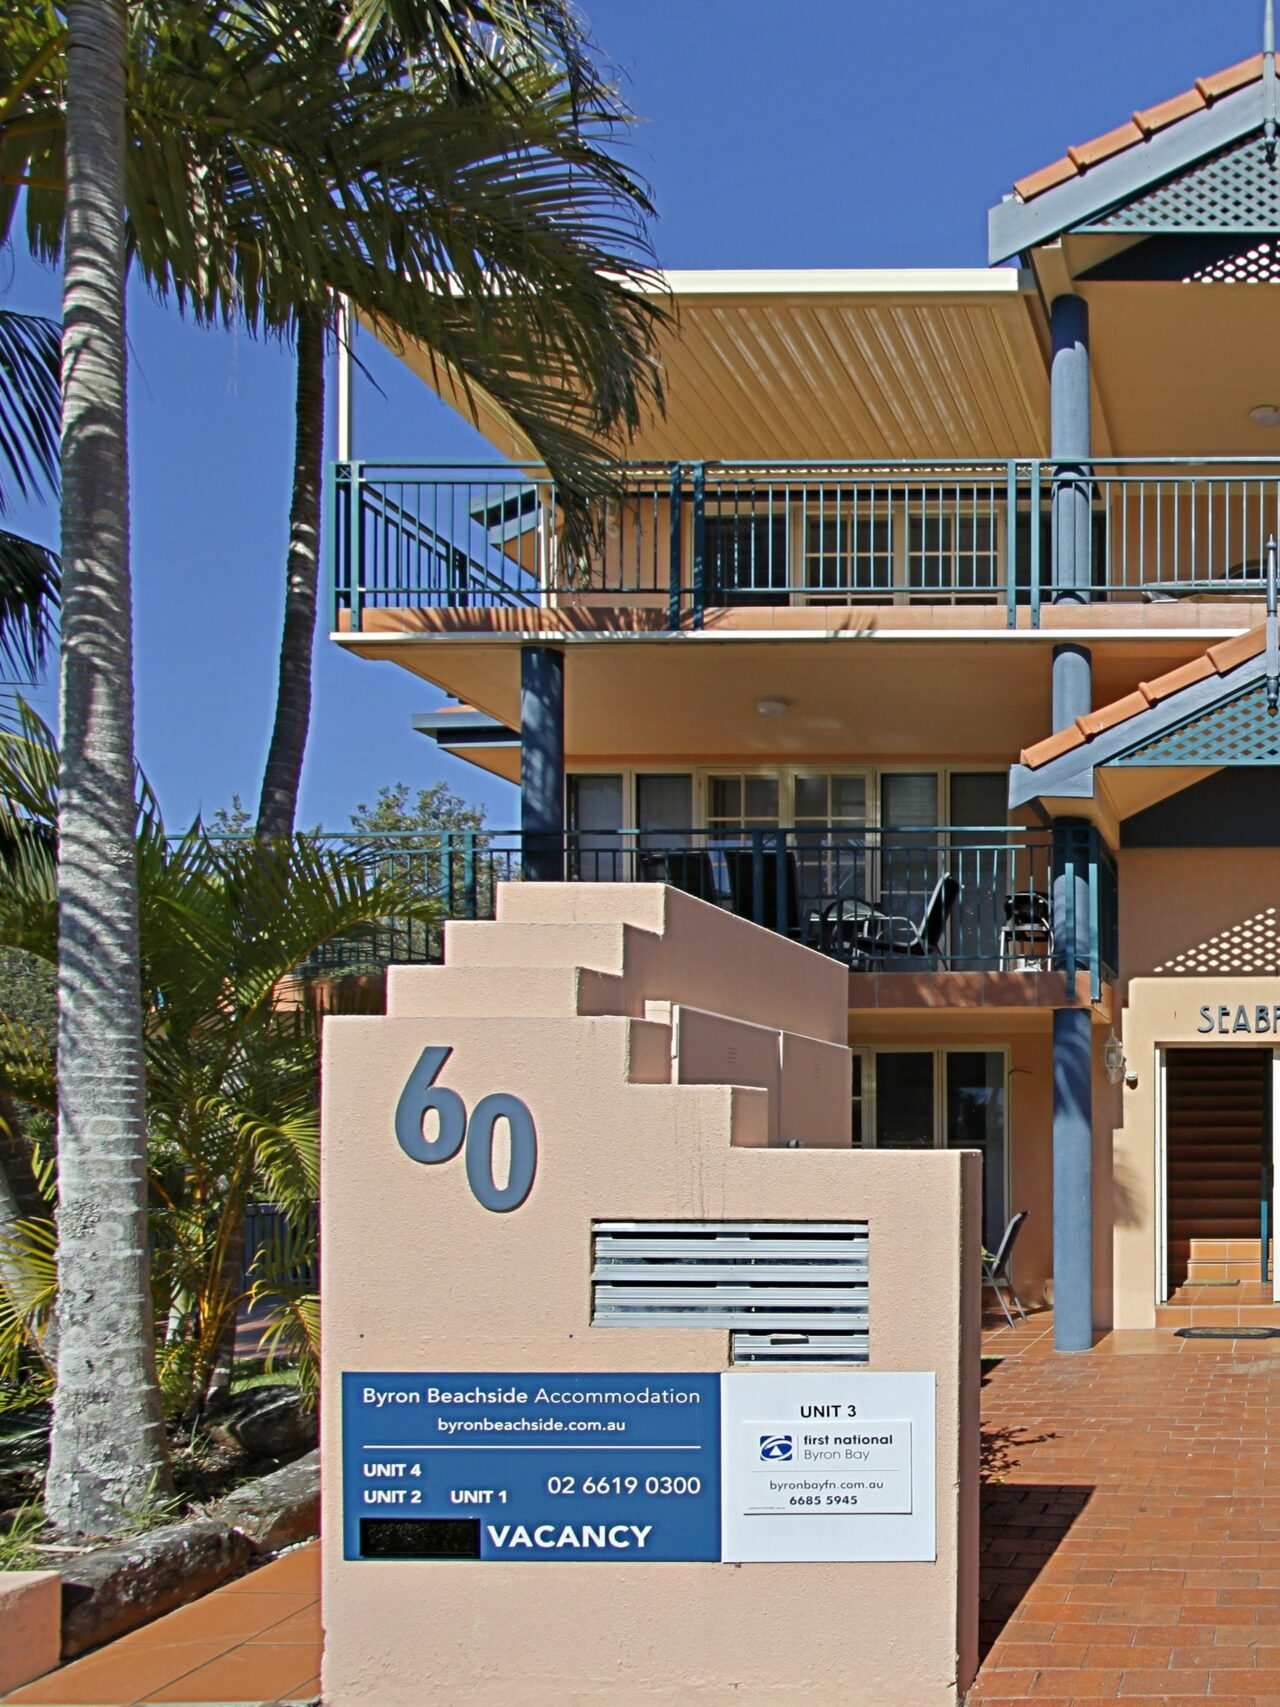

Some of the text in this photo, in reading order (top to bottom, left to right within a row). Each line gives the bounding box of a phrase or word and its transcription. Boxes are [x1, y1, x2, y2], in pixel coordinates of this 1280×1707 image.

[394, 1046, 538, 1213] 60
[363, 1387, 700, 1407] Byron Beachside Accommodation
[801, 1405, 857, 1418] UNIT 3
[437, 1417, 626, 1434] byronbeachside.com.au
[803, 1433, 894, 1445] first national
[804, 1449, 870, 1462] Byron Bay
[363, 1463, 422, 1477] UNIT 4
[547, 1476, 701, 1495] 02 6619 0300
[769, 1479, 884, 1493] byronbayfn.com.au
[363, 1490, 422, 1504] UNIT 2
[450, 1490, 508, 1504] UNIT 1
[789, 1495, 858, 1506] 6685 5945
[487, 1525, 653, 1548] VACANCY
